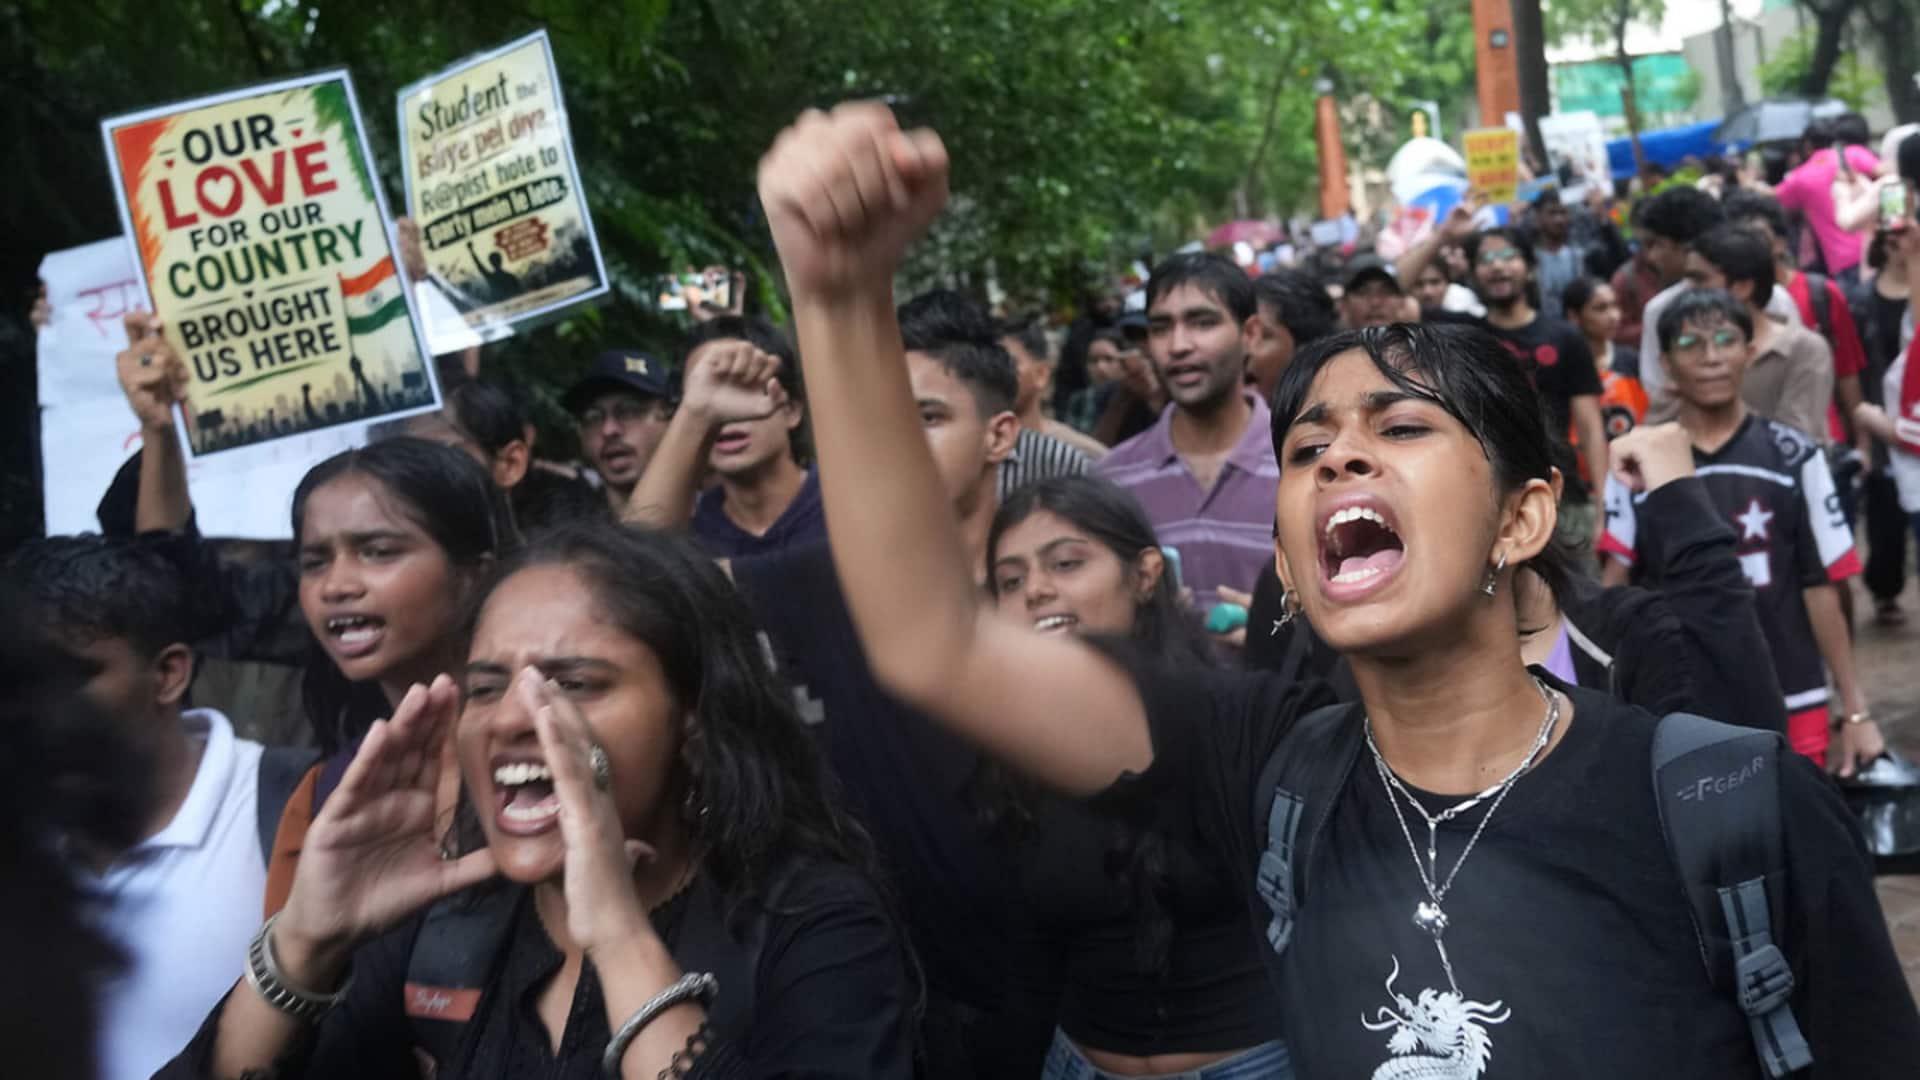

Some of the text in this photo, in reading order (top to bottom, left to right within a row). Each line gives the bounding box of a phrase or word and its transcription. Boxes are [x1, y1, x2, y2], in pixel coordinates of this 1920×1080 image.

[418, 71, 510, 141] Student
[183, 113, 279, 165] OUR
[156, 140, 339, 230] LOVE
[420, 146, 559, 216] R@pist hote to
[168, 218, 364, 299] COUNTRY
[190, 202, 324, 252] FOR OUR
[178, 286, 332, 350] BROUGHT
[193, 322, 342, 383] US HERE
[1695, 755, 1765, 801] FGEAR
